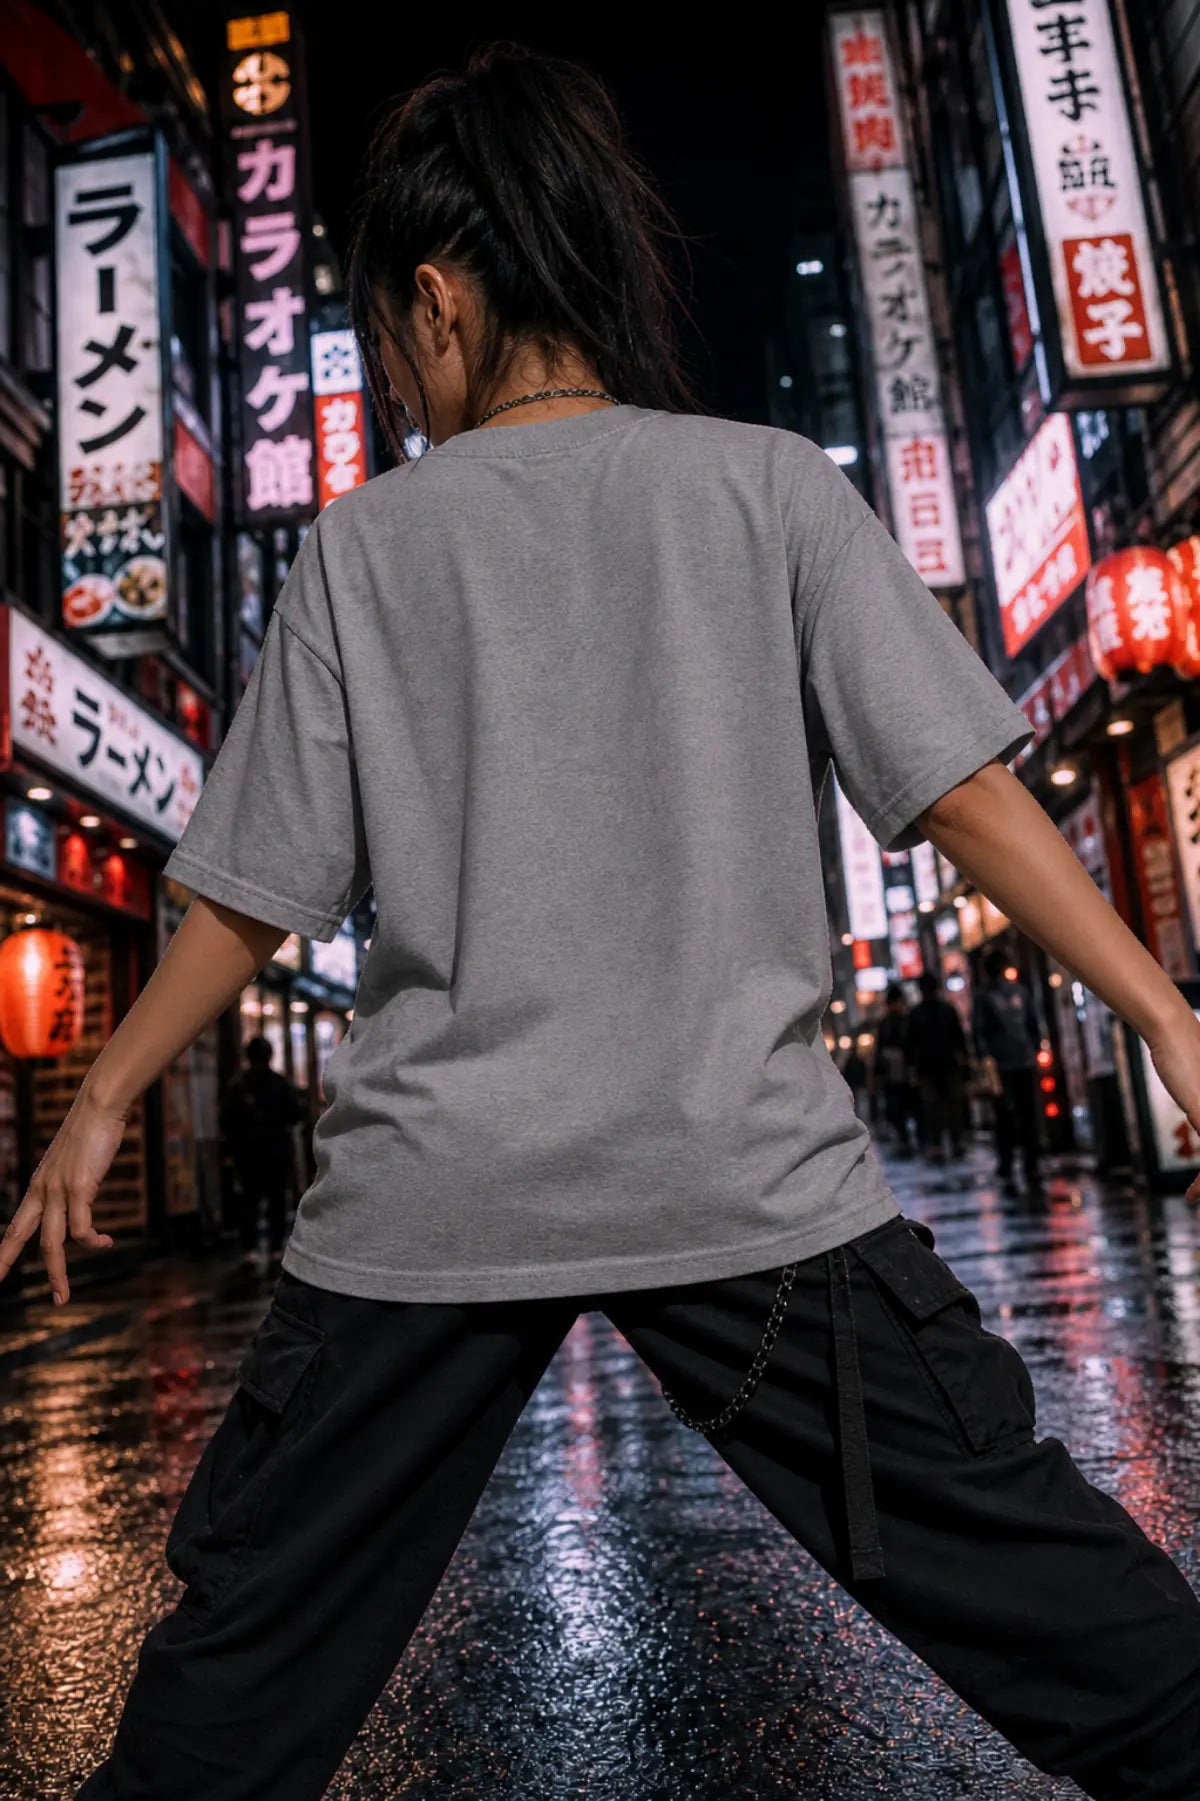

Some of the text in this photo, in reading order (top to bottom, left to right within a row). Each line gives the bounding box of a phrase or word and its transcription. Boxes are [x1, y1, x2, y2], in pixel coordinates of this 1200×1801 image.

[68, 182, 147, 455] ラーメン
[237, 139, 314, 512] カラオケ館
[71, 686, 176, 814] ラーメン
